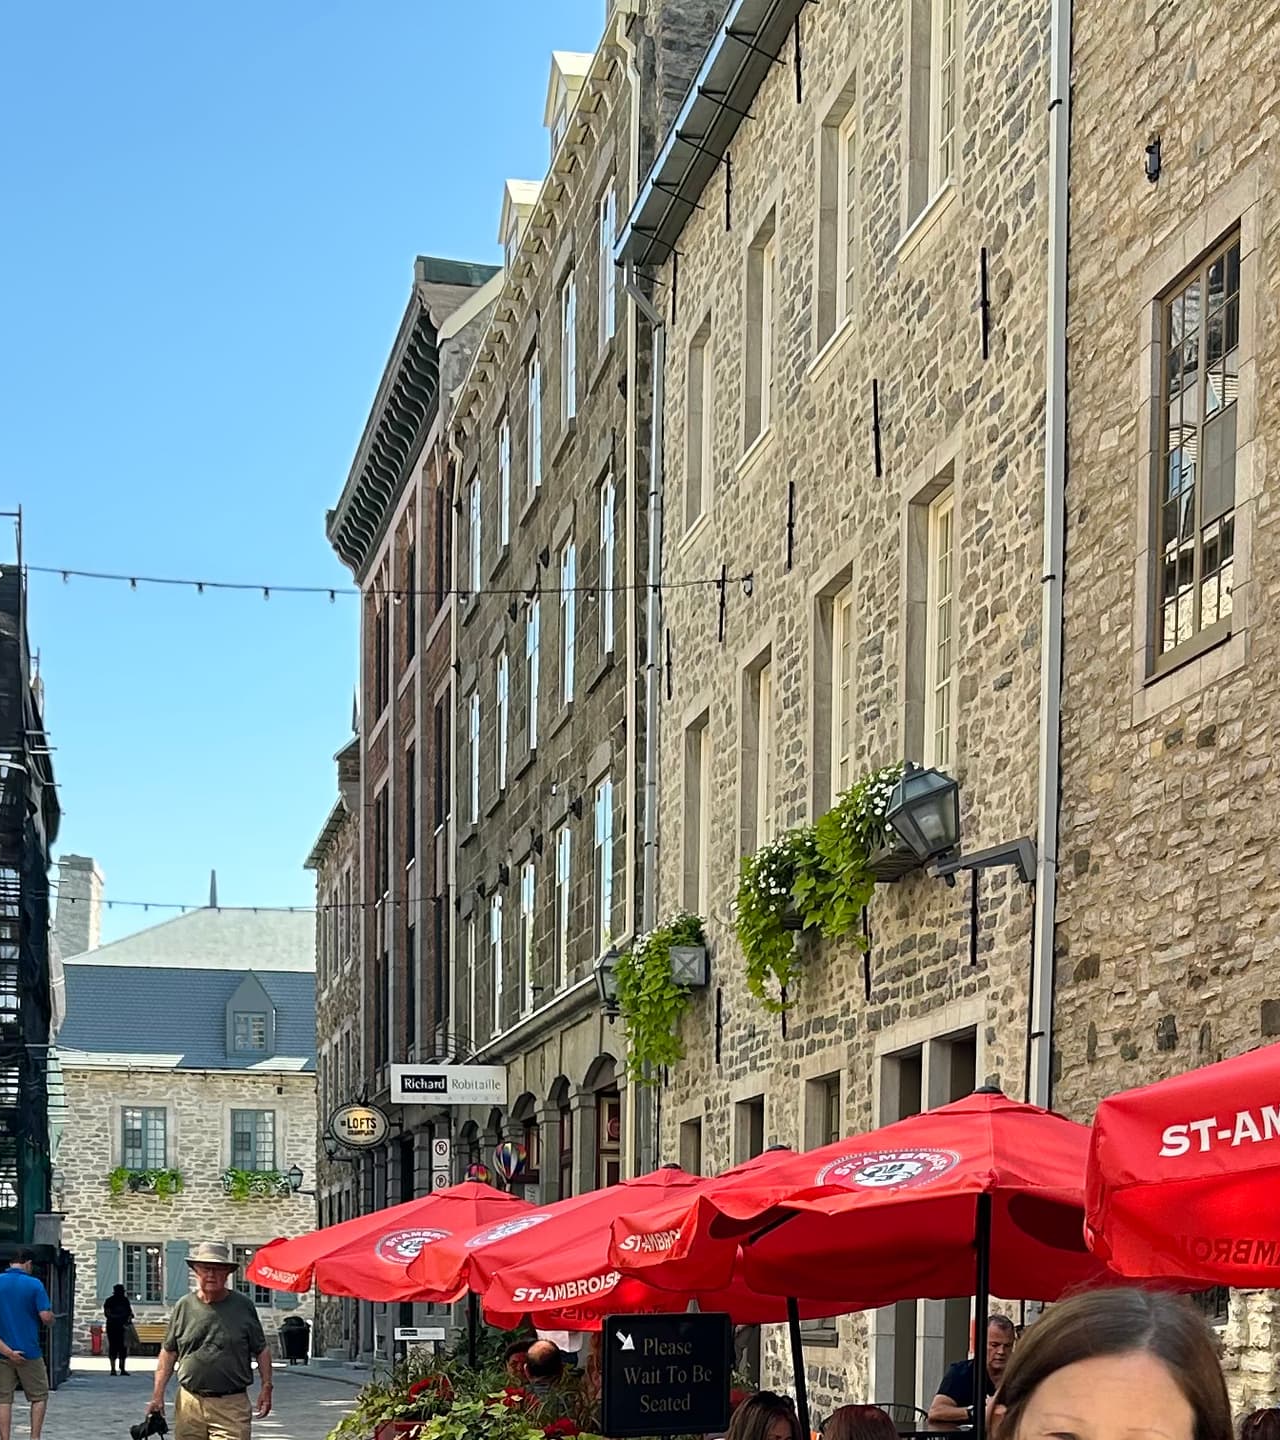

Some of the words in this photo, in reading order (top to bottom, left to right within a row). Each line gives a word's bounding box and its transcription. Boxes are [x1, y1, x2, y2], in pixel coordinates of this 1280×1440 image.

[404, 1078, 445, 1089] Richard
[452, 1078, 501, 1090] Robitaille
[347, 1117, 377, 1129] LOFTS
[643, 1337, 693, 1357] Please
[624, 1366, 662, 1385] Wait
[667, 1365, 688, 1384] To
[692, 1364, 713, 1383] Be
[639, 1392, 691, 1413] Seated
